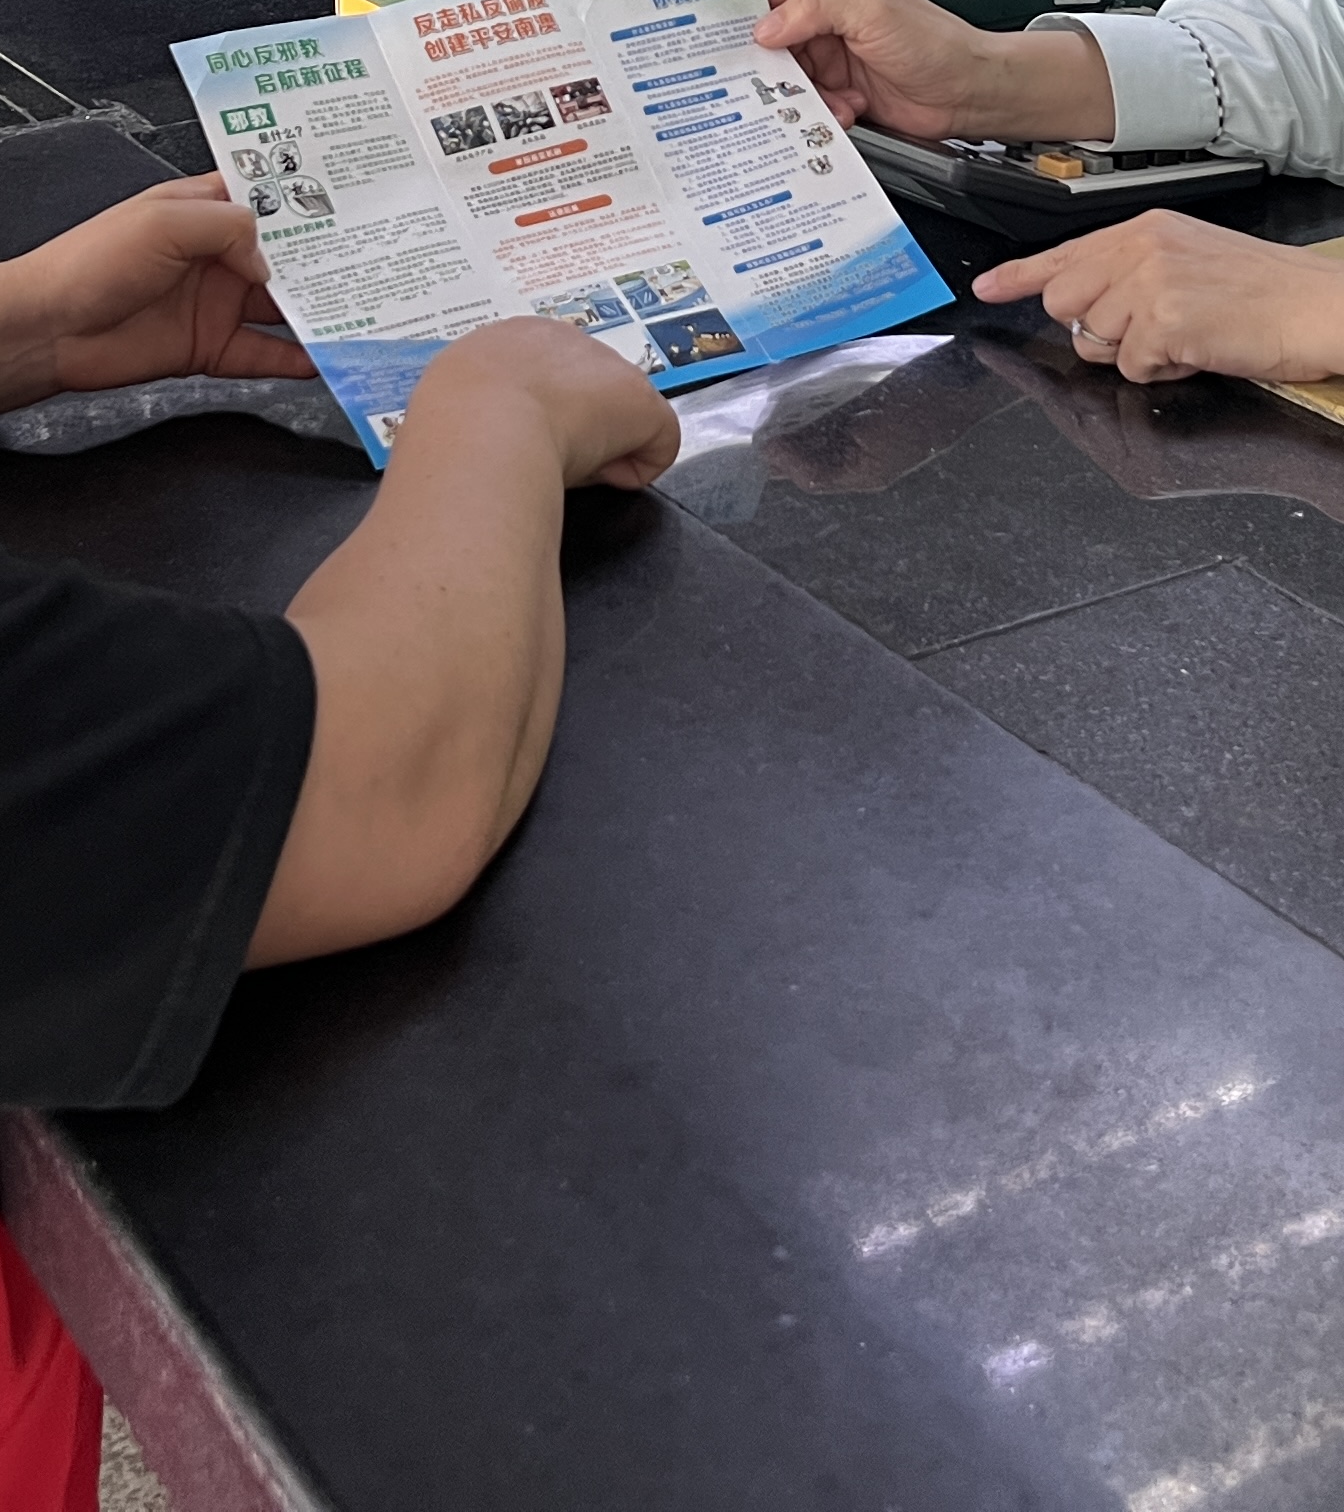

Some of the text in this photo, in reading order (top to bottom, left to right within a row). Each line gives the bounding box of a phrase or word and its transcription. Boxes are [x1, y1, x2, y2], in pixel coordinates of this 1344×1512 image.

[424, 12, 562, 62] 创建平安南澳
[206, 38, 325, 74] 同心反邪教
[254, 59, 370, 96] 启航新征程
[226, 105, 273, 132] 邪教
[258, 125, 303, 144] 是什么?
